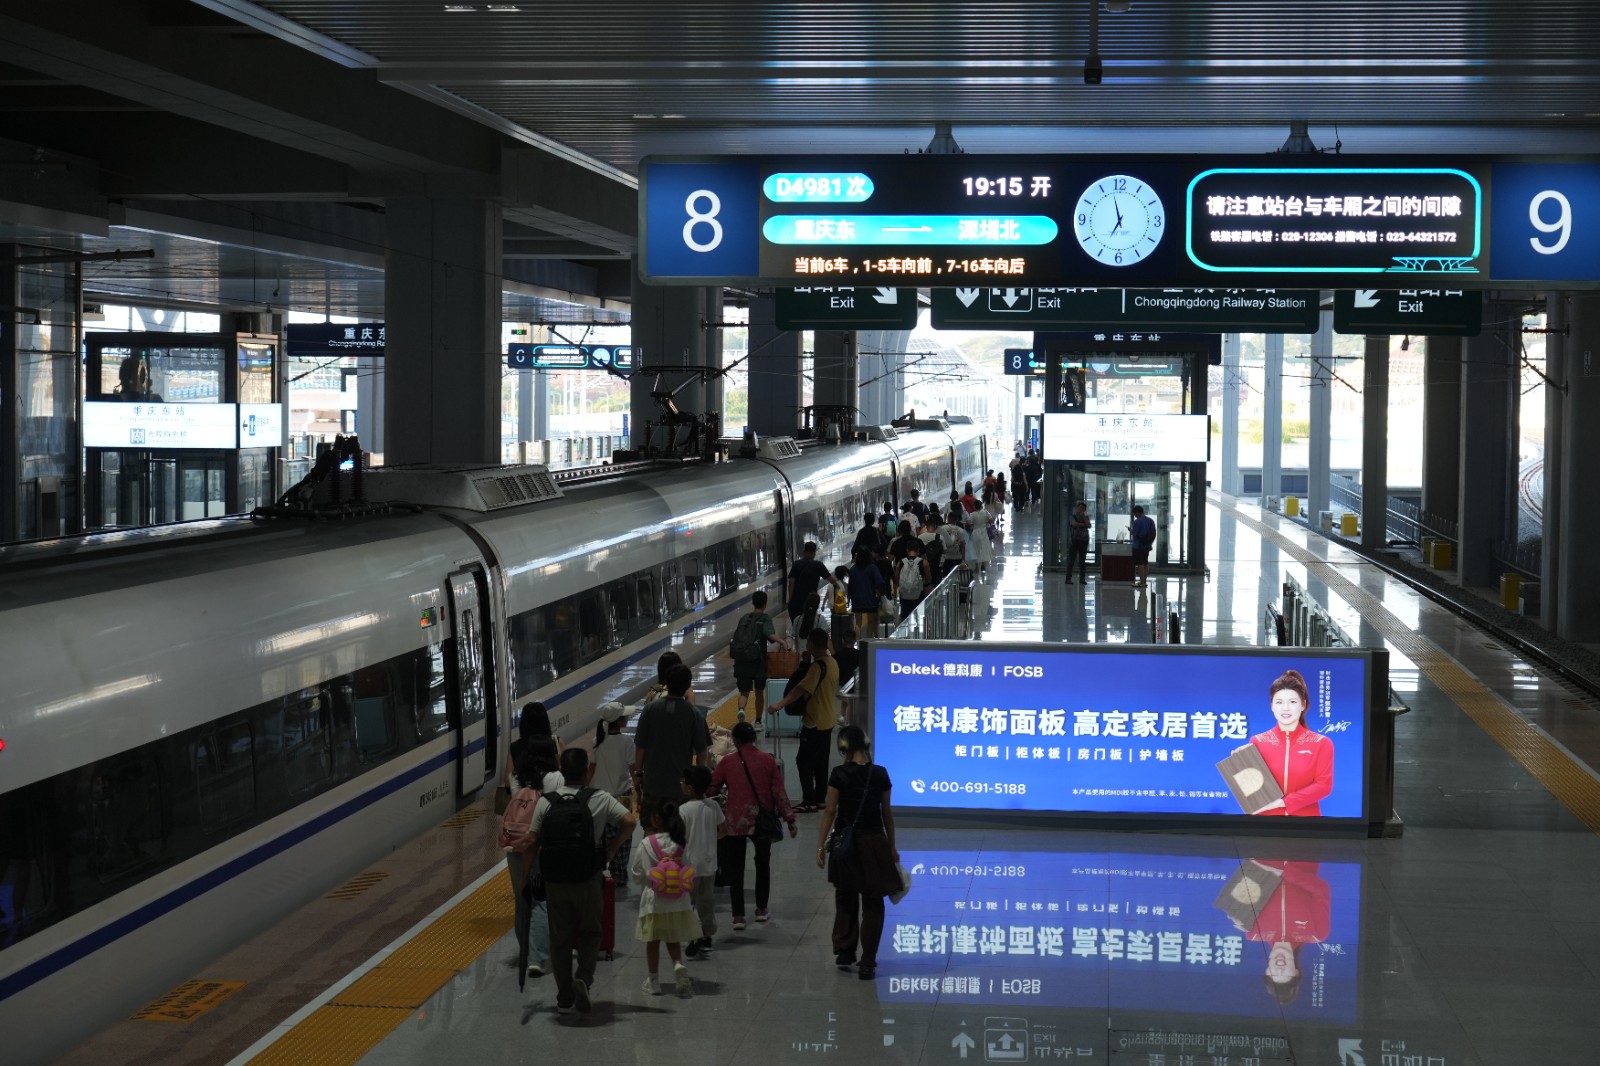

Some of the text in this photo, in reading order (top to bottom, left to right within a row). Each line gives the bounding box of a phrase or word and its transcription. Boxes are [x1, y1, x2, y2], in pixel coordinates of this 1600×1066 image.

[777, 175, 872, 202] D4981 次
[962, 176, 1052, 198] 19:15 开
[1113, 178, 1127, 191] 12
[1205, 195, 1462, 218] 请注意站台与车厢之间的间隙
[682, 189, 723, 253] 8
[1078, 213, 1086, 226] 9
[1153, 215, 1162, 228] 3
[1529, 190, 1572, 255] 9
[794, 218, 857, 243] 重庆东
[1114, 252, 1123, 264] 6
[830, 296, 855, 308] Exit
[1037, 296, 1061, 308] Exit
[1134, 296, 1306, 310] Chongqingdong Railway Station
[1398, 300, 1424, 313] Exit
[1012, 355, 1022, 370] 8
[890, 662, 1044, 678] Dekek 德科康 FOSB
[893, 705, 1249, 741] 德科康饰面板 高定家居首选
[954, 744, 1184, 762] 柜门板 柜体板 房门板 护墙板
[930, 780, 1026, 796] 400-691-5188
